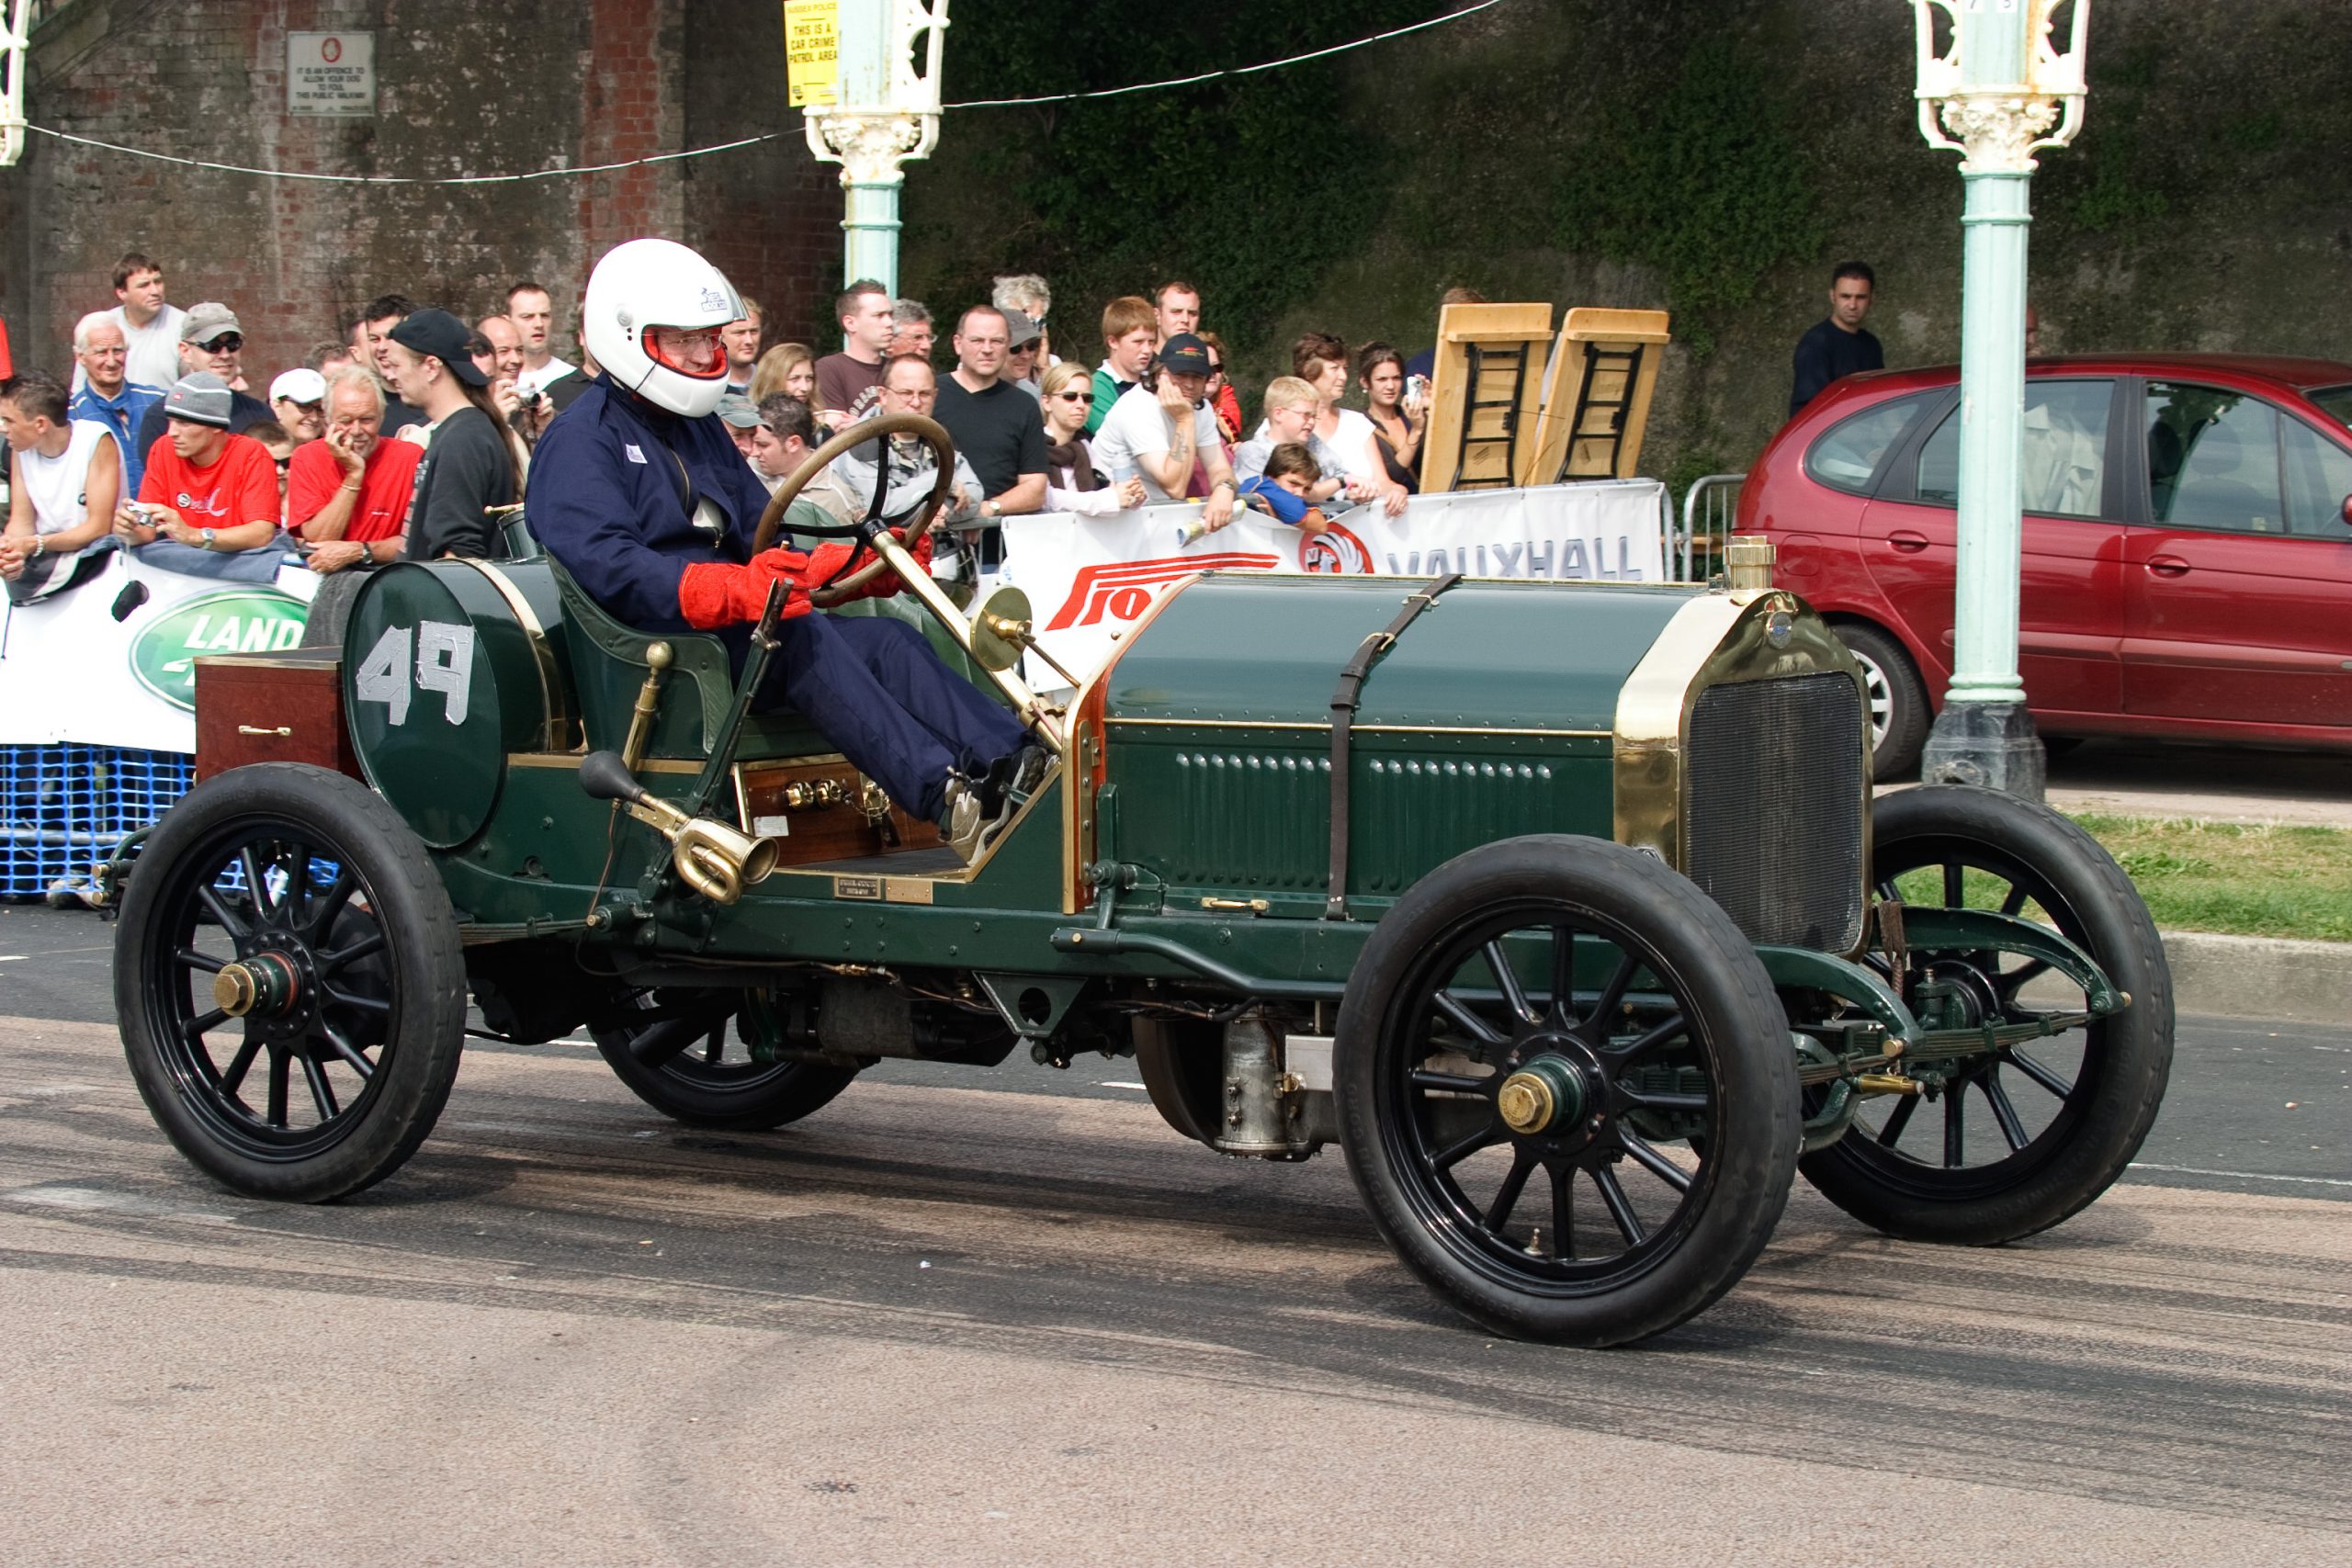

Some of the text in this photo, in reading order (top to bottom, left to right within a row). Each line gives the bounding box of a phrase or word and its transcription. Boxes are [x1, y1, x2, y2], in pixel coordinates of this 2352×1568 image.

[813, 3, 837, 11] POLICE
[794, 23, 831, 37] THIS IS A
[791, 37, 835, 51] CAR CRIME
[789, 50, 838, 63] PATROL AREA
[183, 615, 306, 652] LAND
[356, 620, 475, 726] 49
